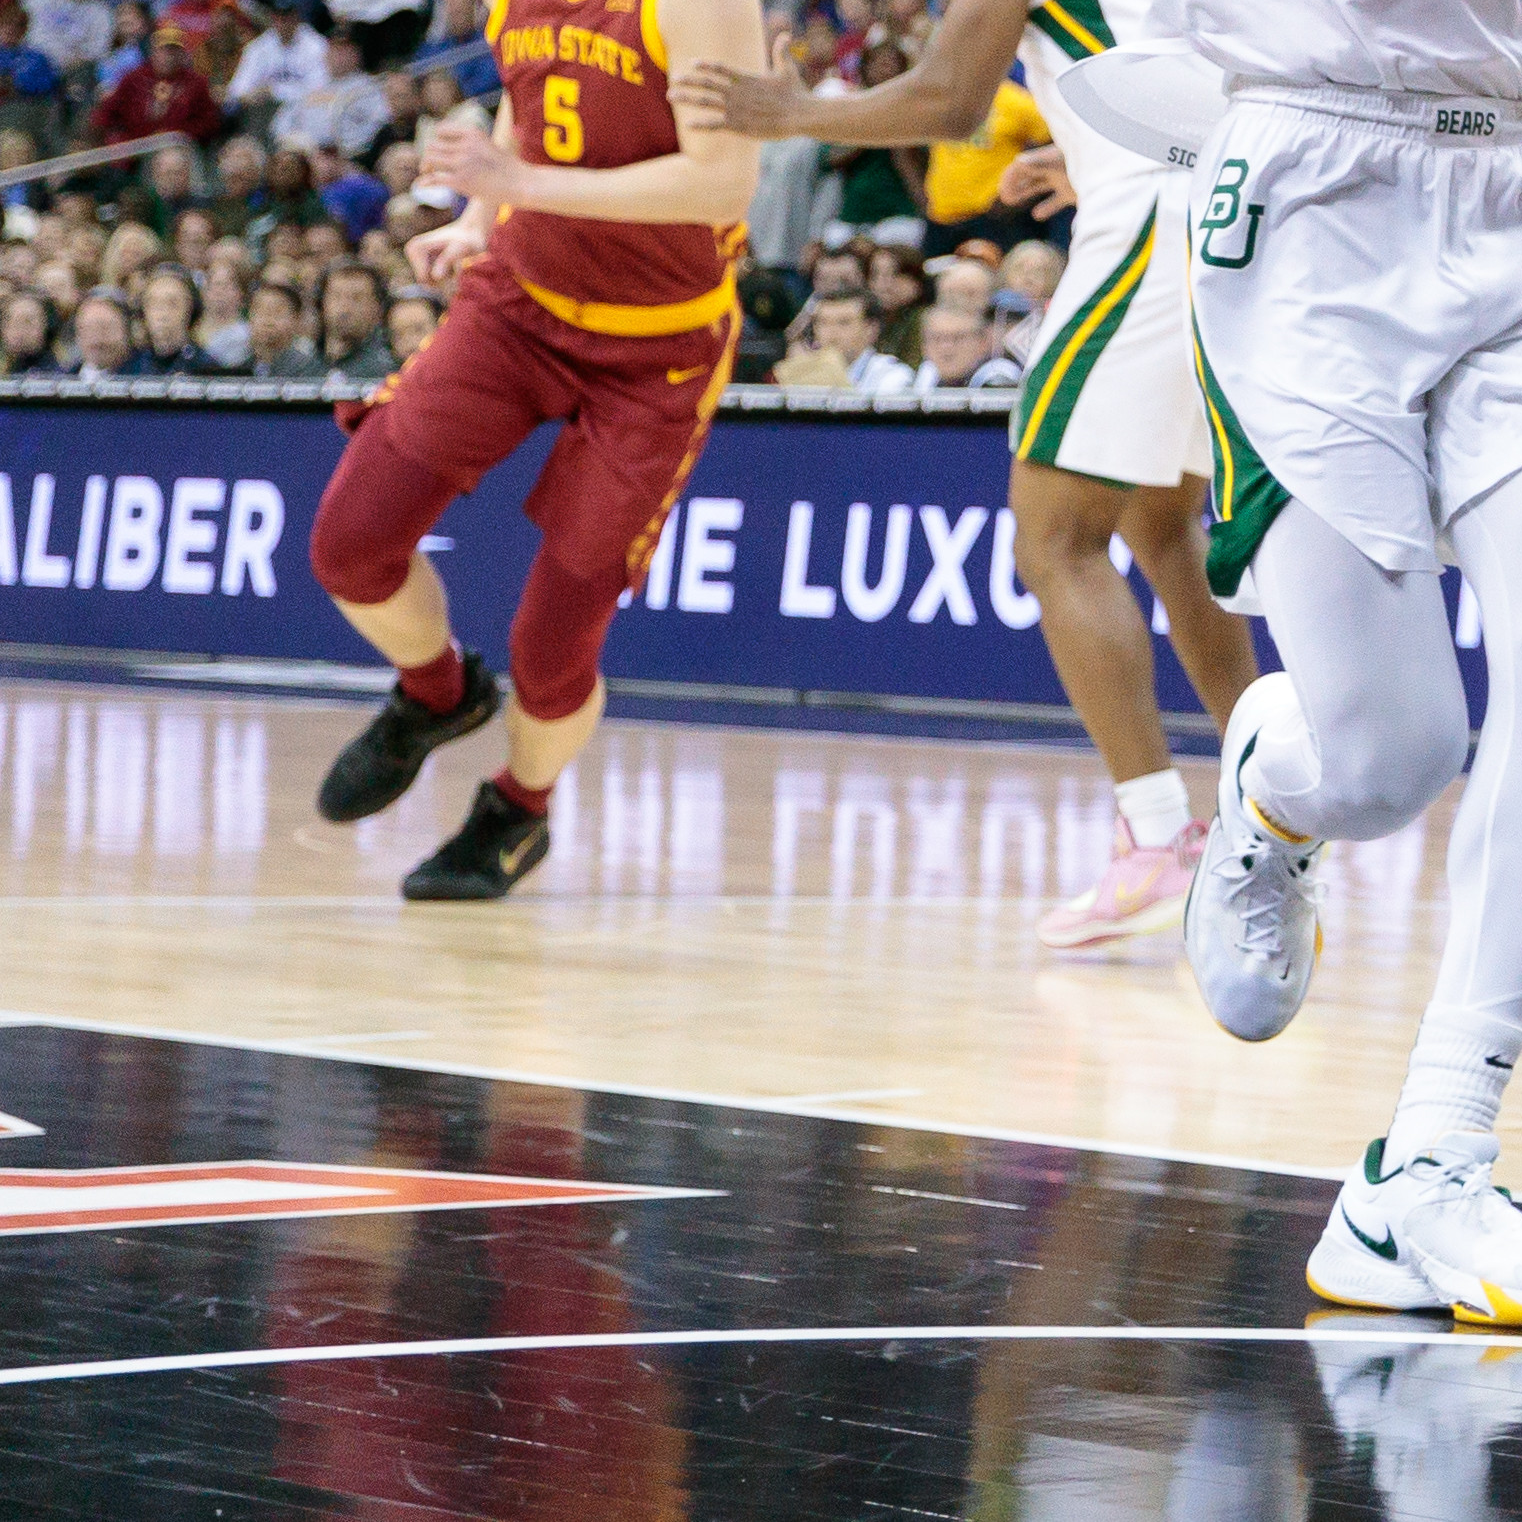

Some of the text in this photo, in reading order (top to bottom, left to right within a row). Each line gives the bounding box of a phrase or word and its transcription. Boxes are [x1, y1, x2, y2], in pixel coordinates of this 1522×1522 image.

[557, 24, 645, 87] STATE
[542, 74, 584, 163] 5
[1435, 109, 1496, 138] BEARS
[1167, 146, 1198, 168] SIC
[0, 473, 286, 597] LIBER
